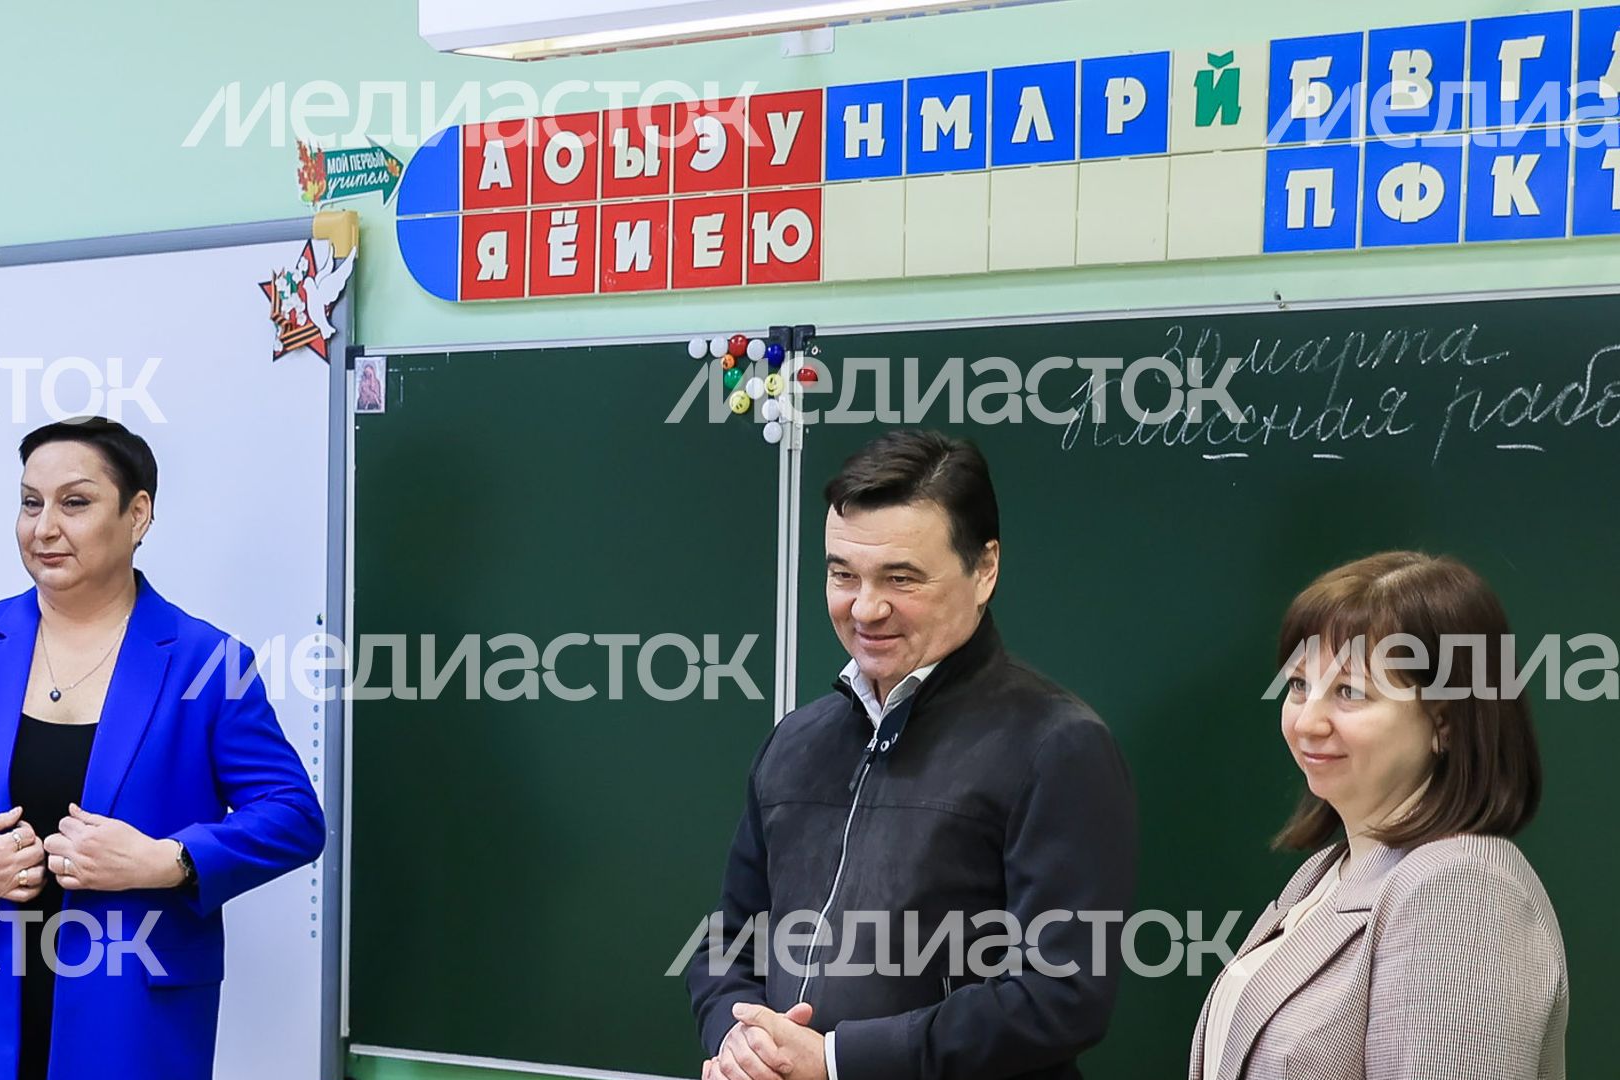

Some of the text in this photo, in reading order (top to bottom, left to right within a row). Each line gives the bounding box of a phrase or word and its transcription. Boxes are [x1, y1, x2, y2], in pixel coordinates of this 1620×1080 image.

[481, 140, 513, 190] А
[543, 131, 585, 185] О
[612, 126, 661, 178] Ы
[690, 117, 727, 172] Э
[767, 111, 803, 166] У
[843, 103, 885, 158] Н
[920, 95, 973, 152] М
[1011, 86, 1055, 144] Л
[1104, 78, 1146, 134] Р
[1193, 50, 1242, 127] Й
[1289, 56, 1333, 120] Б
[1387, 49, 1434, 110] В
[1498, 35, 1546, 102] Г
[327, 149, 386, 174] МОЙ ПЕРВЫЙ
[1285, 168, 1335, 229] П
[1377, 162, 1445, 223] Ф
[1491, 154, 1541, 217] К
[476, 208, 814, 282] Я Ё И Е Ю
[1230, 324, 1510, 404] марта
